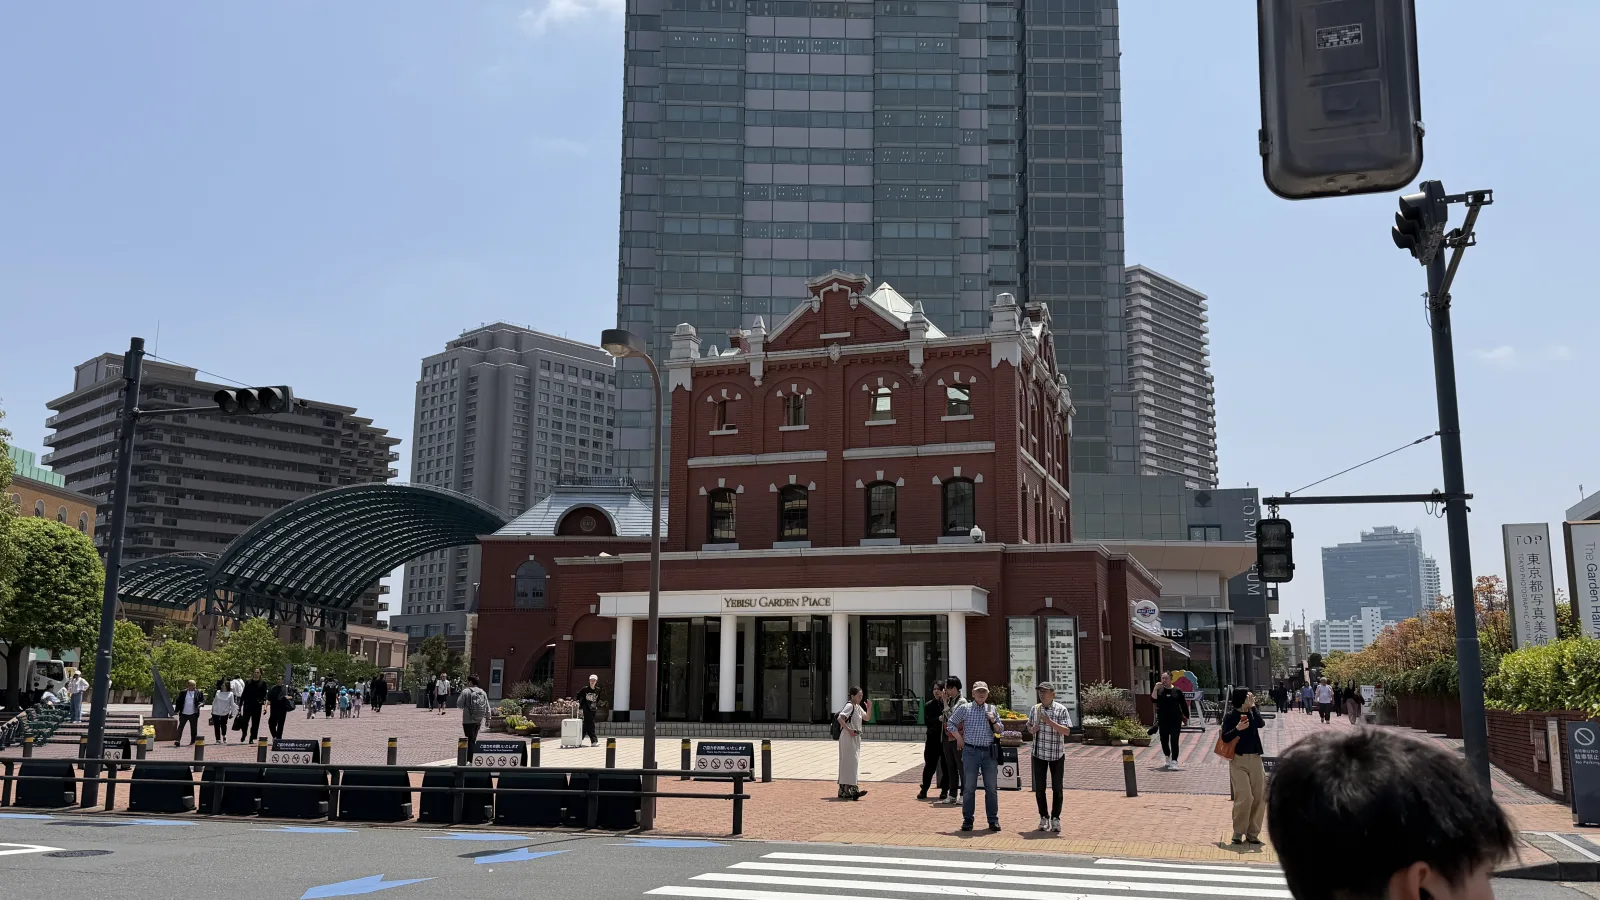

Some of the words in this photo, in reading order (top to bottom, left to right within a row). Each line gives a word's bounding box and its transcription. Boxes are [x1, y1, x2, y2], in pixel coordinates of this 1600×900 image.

[1242, 497, 1256, 527] TOP
[1514, 535, 1542, 545] TOP
[1585, 542, 1596, 561] The
[1518, 553, 1526, 573] TOKYO
[1587, 563, 1599, 603] Garden
[724, 597, 757, 608] YEBISU
[758, 596, 799, 607] GARDEN
[801, 595, 831, 607] PLACE
[1520, 573, 1530, 619] PHOTOGRAPHIC
